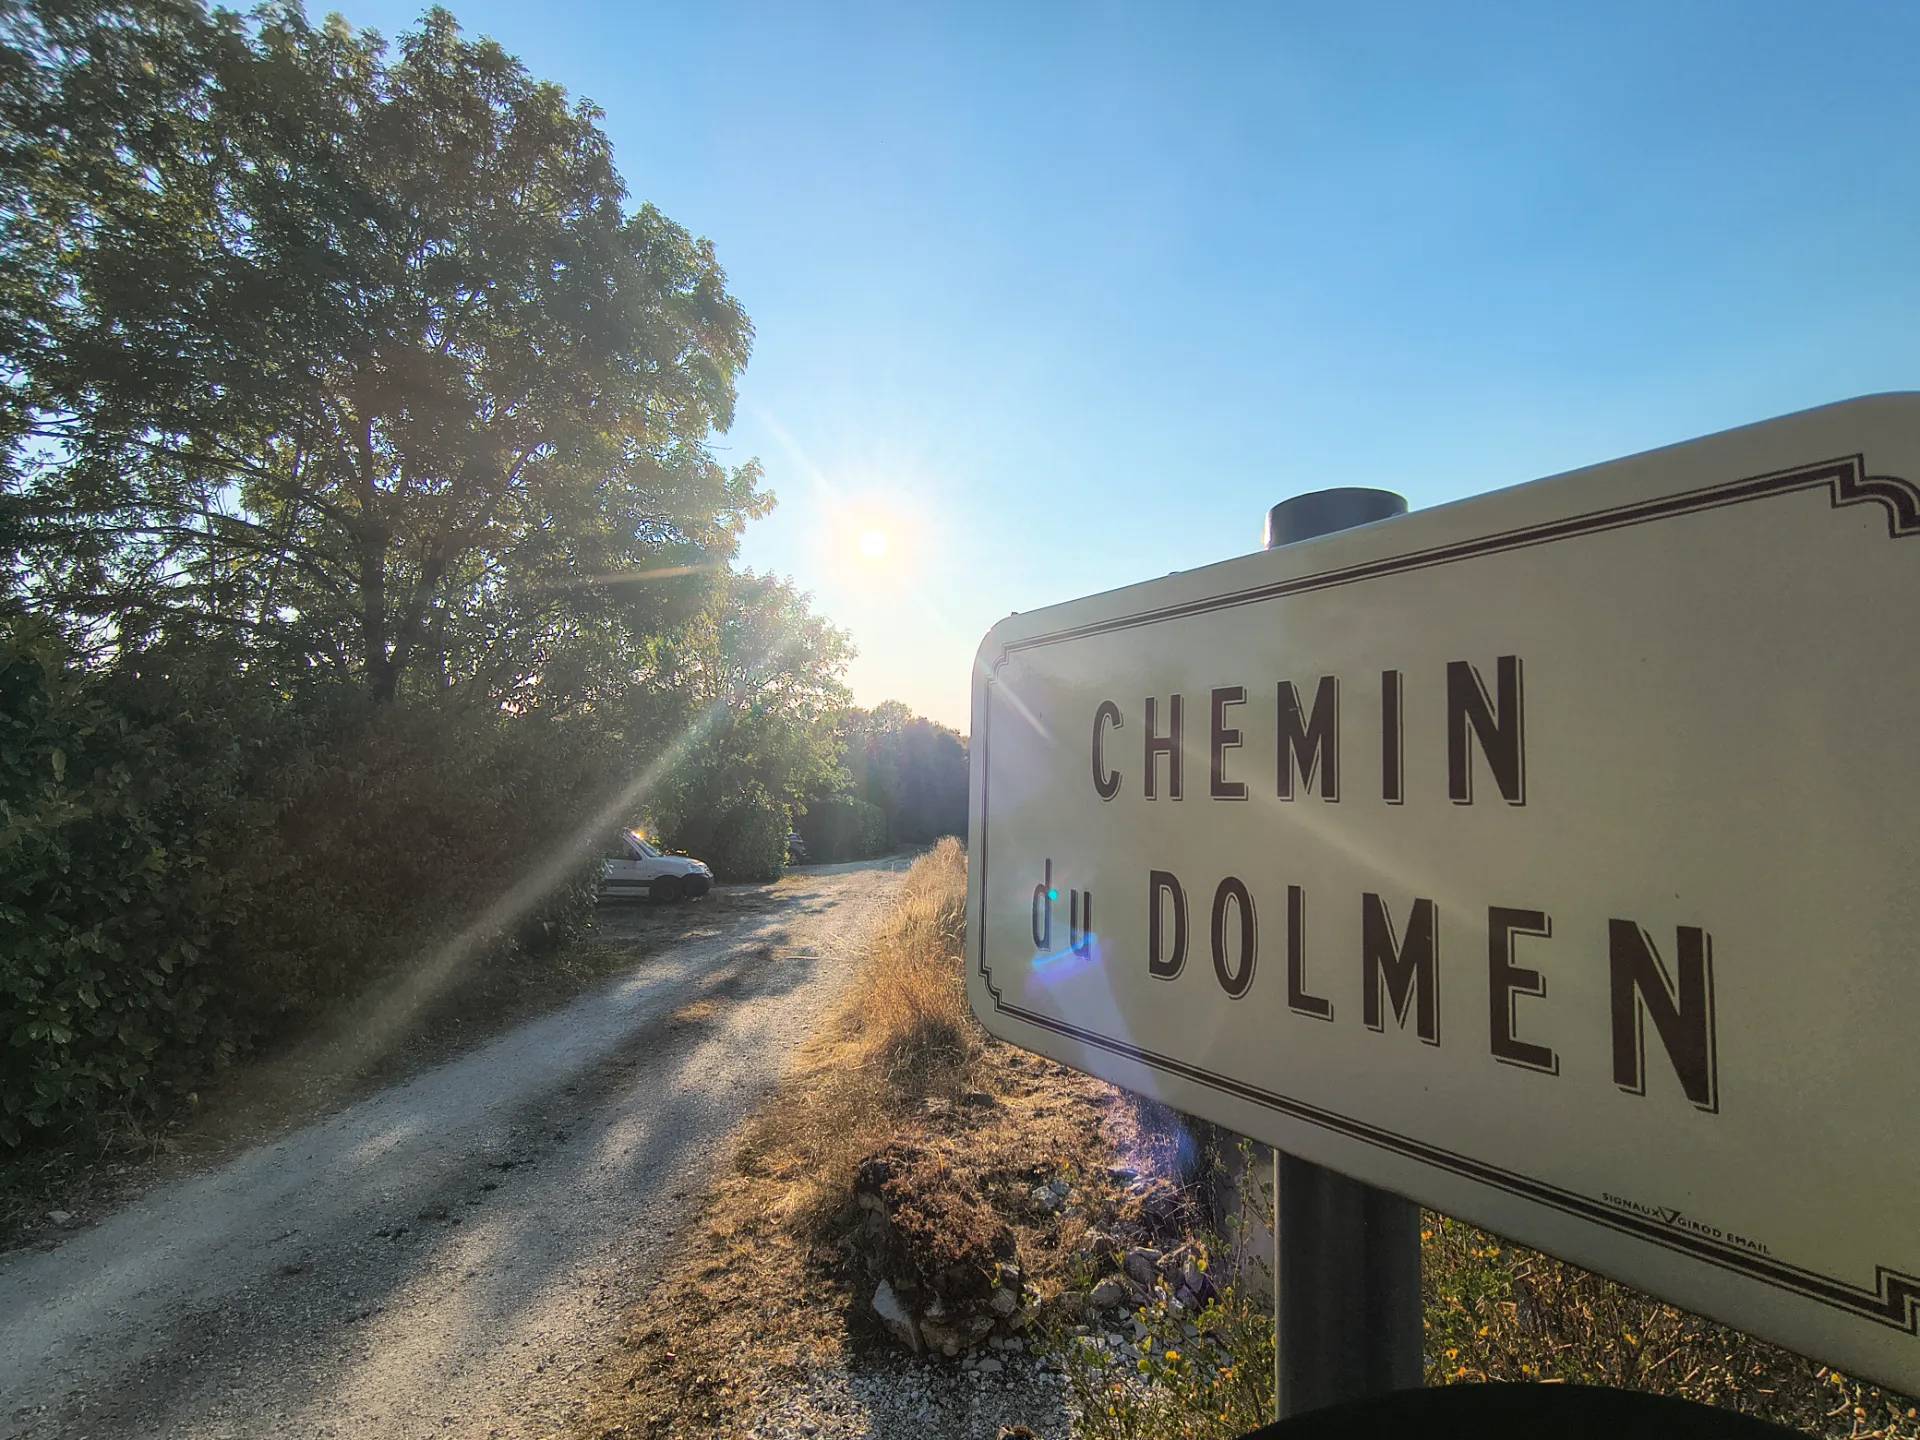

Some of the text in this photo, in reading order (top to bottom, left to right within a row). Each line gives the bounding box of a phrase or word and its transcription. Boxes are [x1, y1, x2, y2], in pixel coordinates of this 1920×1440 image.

[1091, 655, 1526, 806] CHEMIN
[1032, 858, 1719, 1114] du DOLMEN
[1602, 1192, 1660, 1218] SIGNAUX
[1677, 1217, 1722, 1238] GIROD
